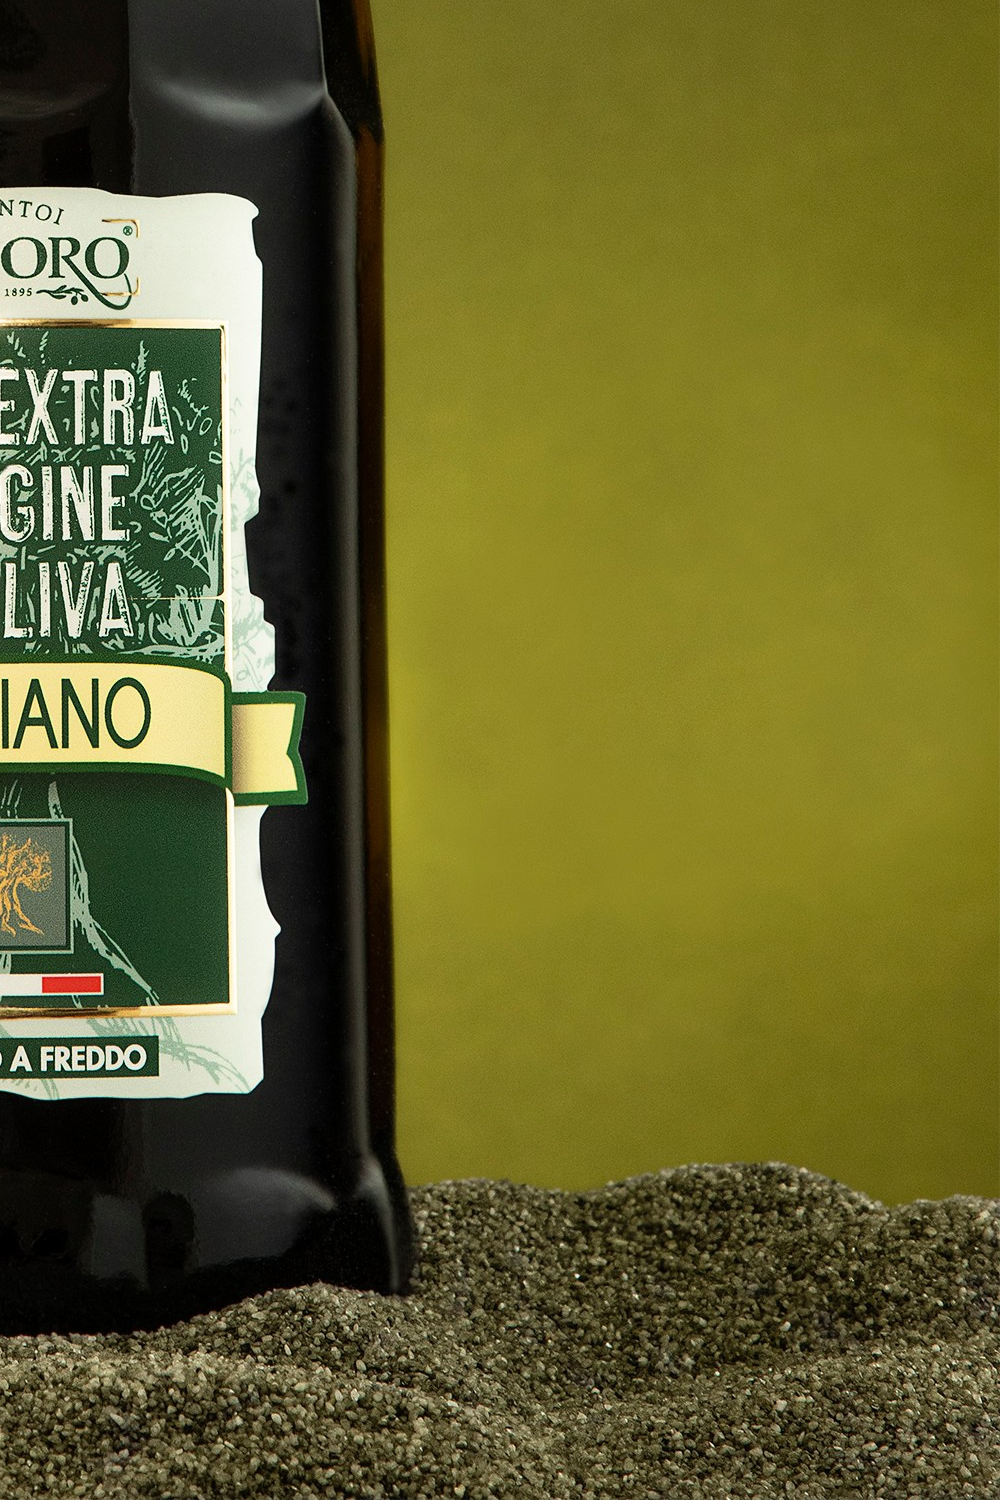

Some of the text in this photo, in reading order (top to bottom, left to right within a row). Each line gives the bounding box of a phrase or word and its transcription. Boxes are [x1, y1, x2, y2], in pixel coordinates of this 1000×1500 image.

[4, 288, 32, 297] 1895
[11, 1046, 33, 1072] A
[41, 1044, 147, 1071] FREDDO
